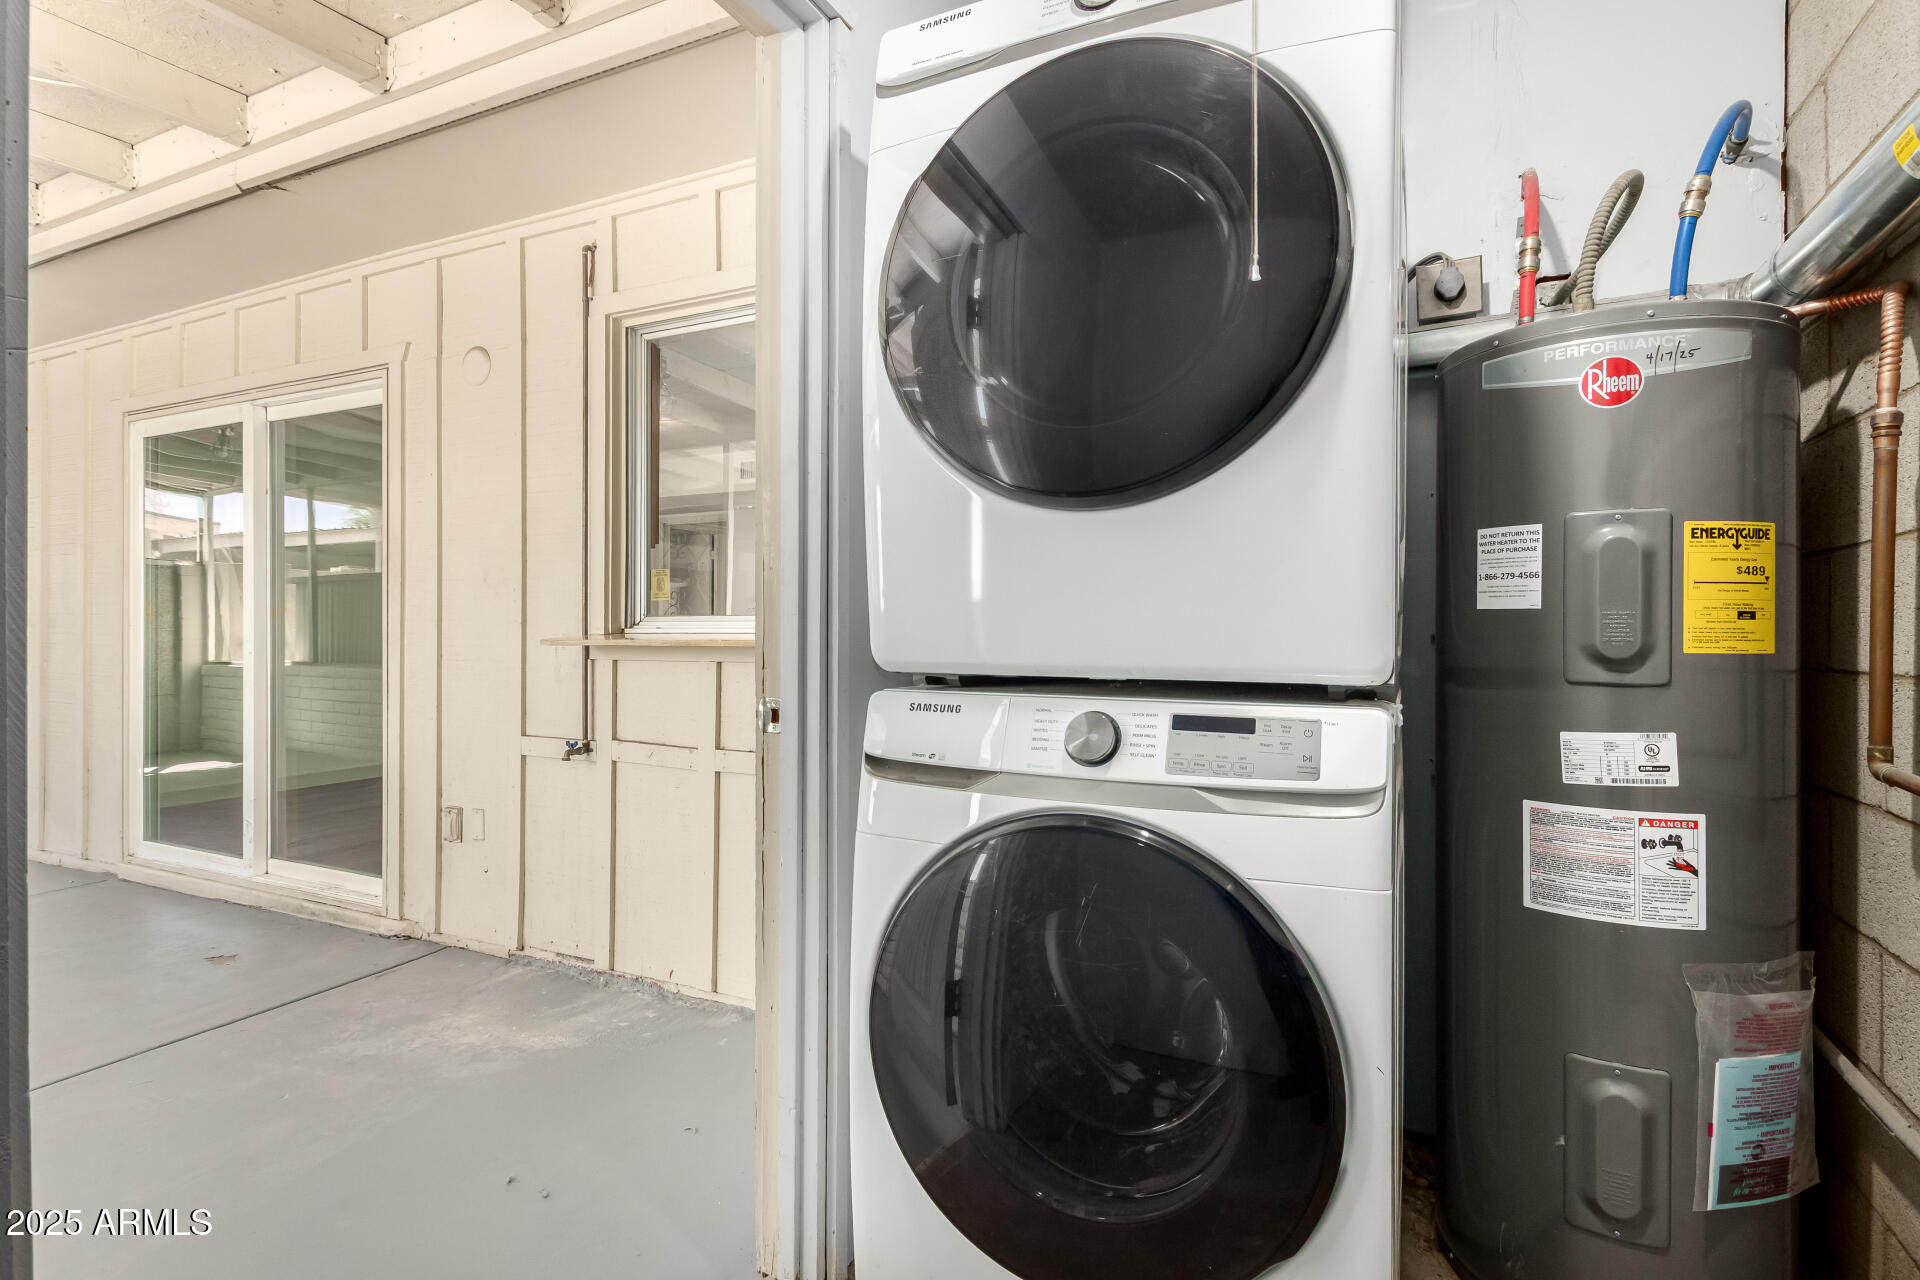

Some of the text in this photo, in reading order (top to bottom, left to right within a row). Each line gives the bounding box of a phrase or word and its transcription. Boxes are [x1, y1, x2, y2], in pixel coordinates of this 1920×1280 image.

[919, 8, 972, 32] SAMSUNG
[1543, 334, 1687, 363] PERFORMANCE
[1645, 340, 1702, 376] 4/17/25
[1588, 358, 1640, 400] Rheem
[1691, 527, 1771, 540] ENERGYGUIDE
[1478, 571, 1540, 581] 1-866-279-4566
[1736, 565, 1766, 576] $489
[909, 702, 962, 714] SAMSUNG
[1653, 820, 1695, 829] DANGER
